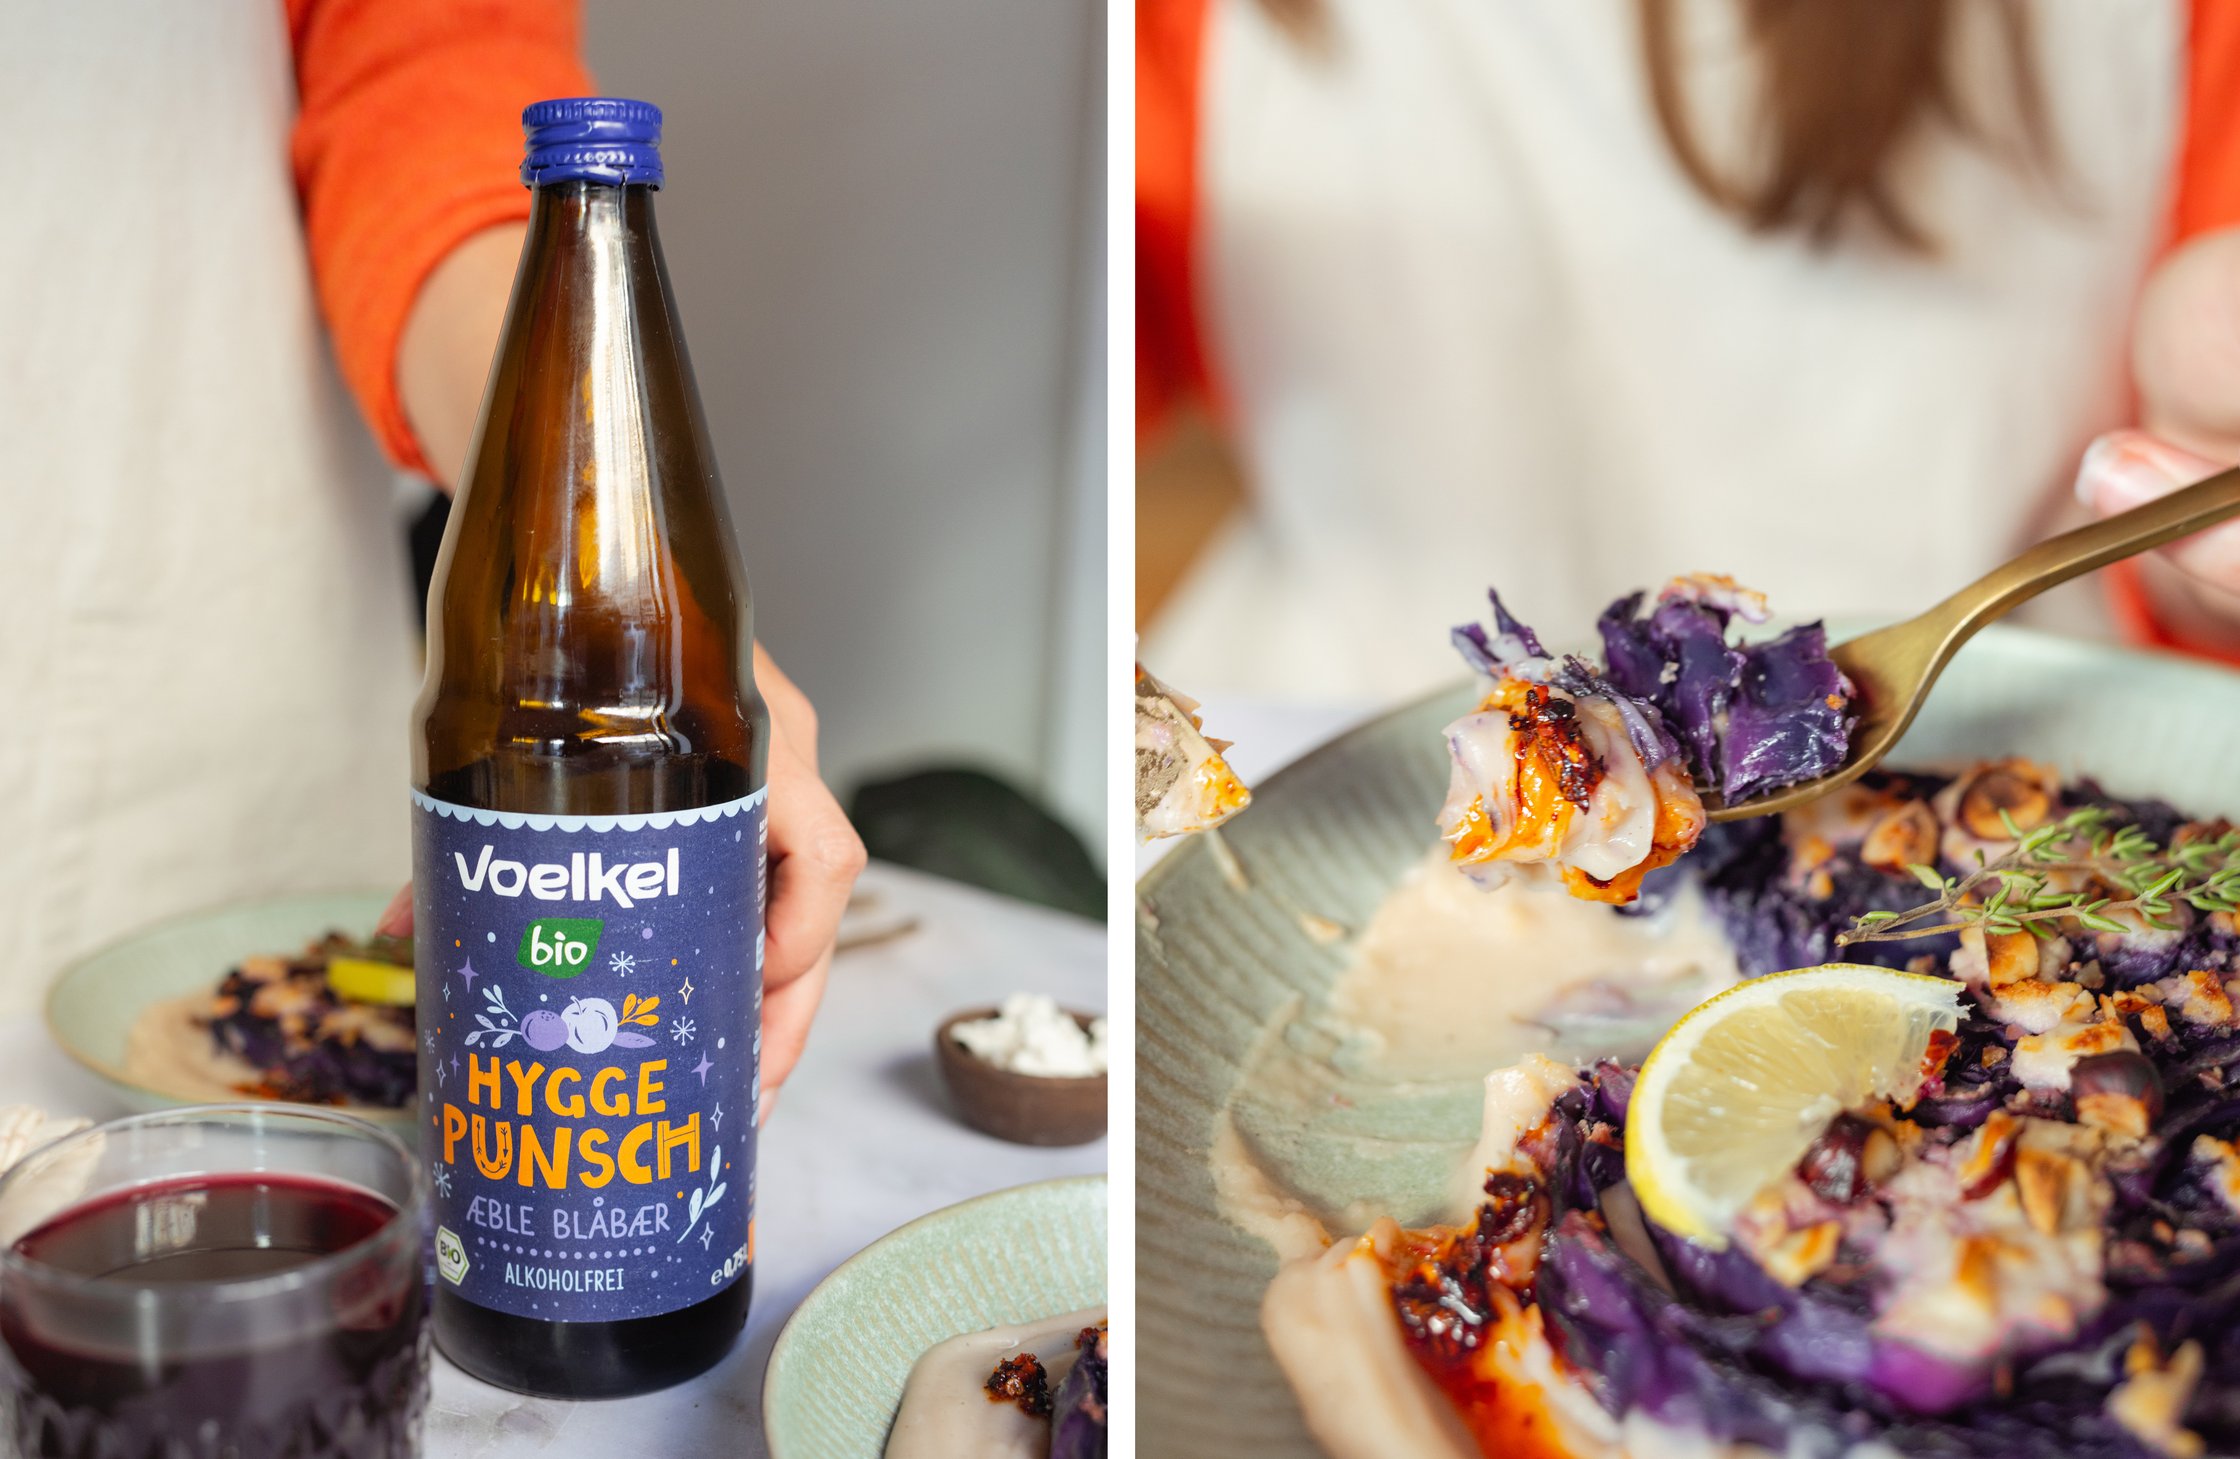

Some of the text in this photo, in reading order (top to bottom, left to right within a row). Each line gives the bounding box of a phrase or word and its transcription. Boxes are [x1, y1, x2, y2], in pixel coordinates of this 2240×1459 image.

[454, 845, 679, 908] Voelkel
[530, 925, 588, 965] bio
[467, 1053, 667, 1118] HYGGE
[443, 1103, 700, 1189] PUNSCH
[466, 1196, 670, 1239] ÆBLE BLÅBÆR
[505, 1262, 625, 1291] ALKOHOLFREI
